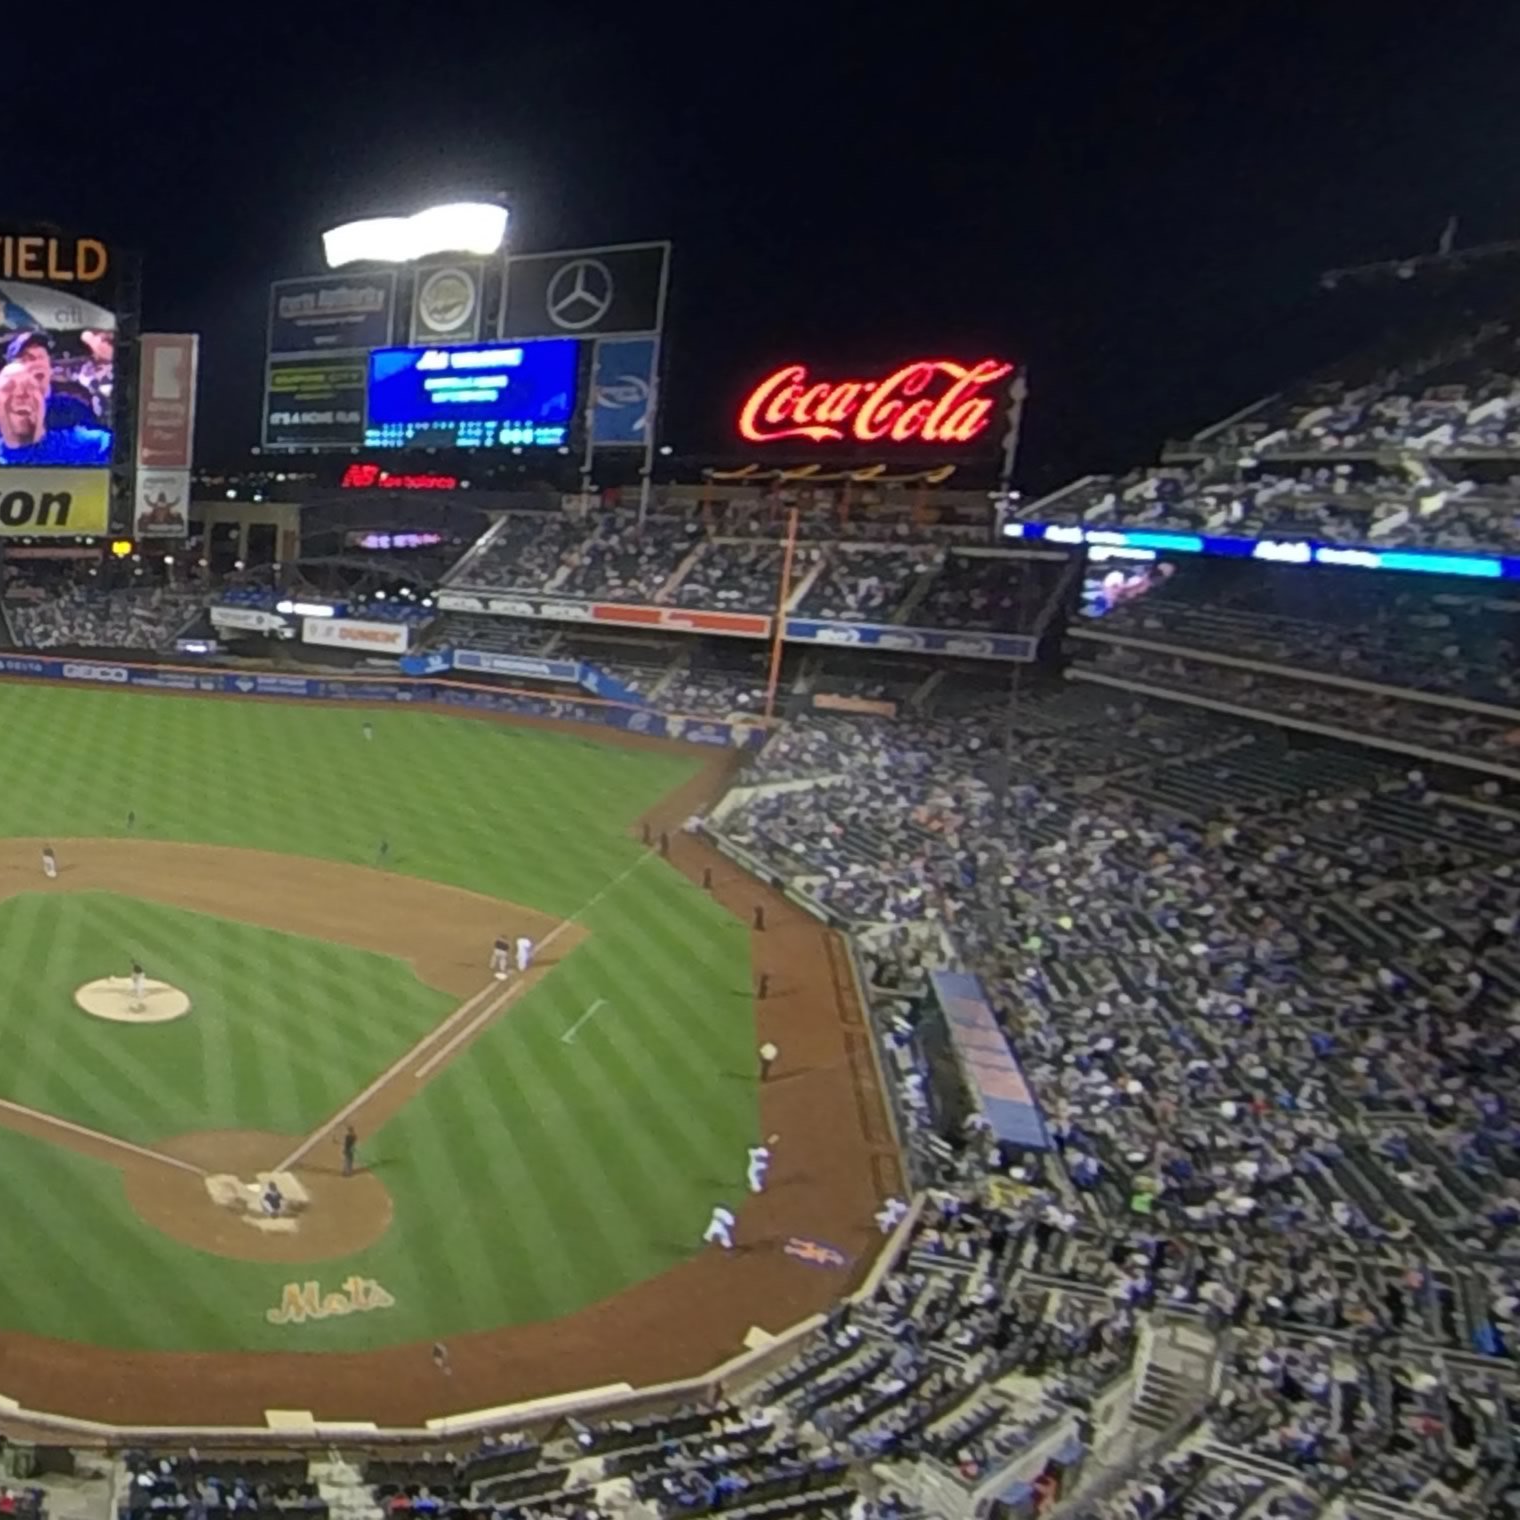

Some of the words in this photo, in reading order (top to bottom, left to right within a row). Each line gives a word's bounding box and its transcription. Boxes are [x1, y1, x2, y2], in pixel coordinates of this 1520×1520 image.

[739, 359, 1014, 441] Coca-Cola
[62, 663, 128, 682] GEICO
[266, 1275, 396, 1324] Mets
